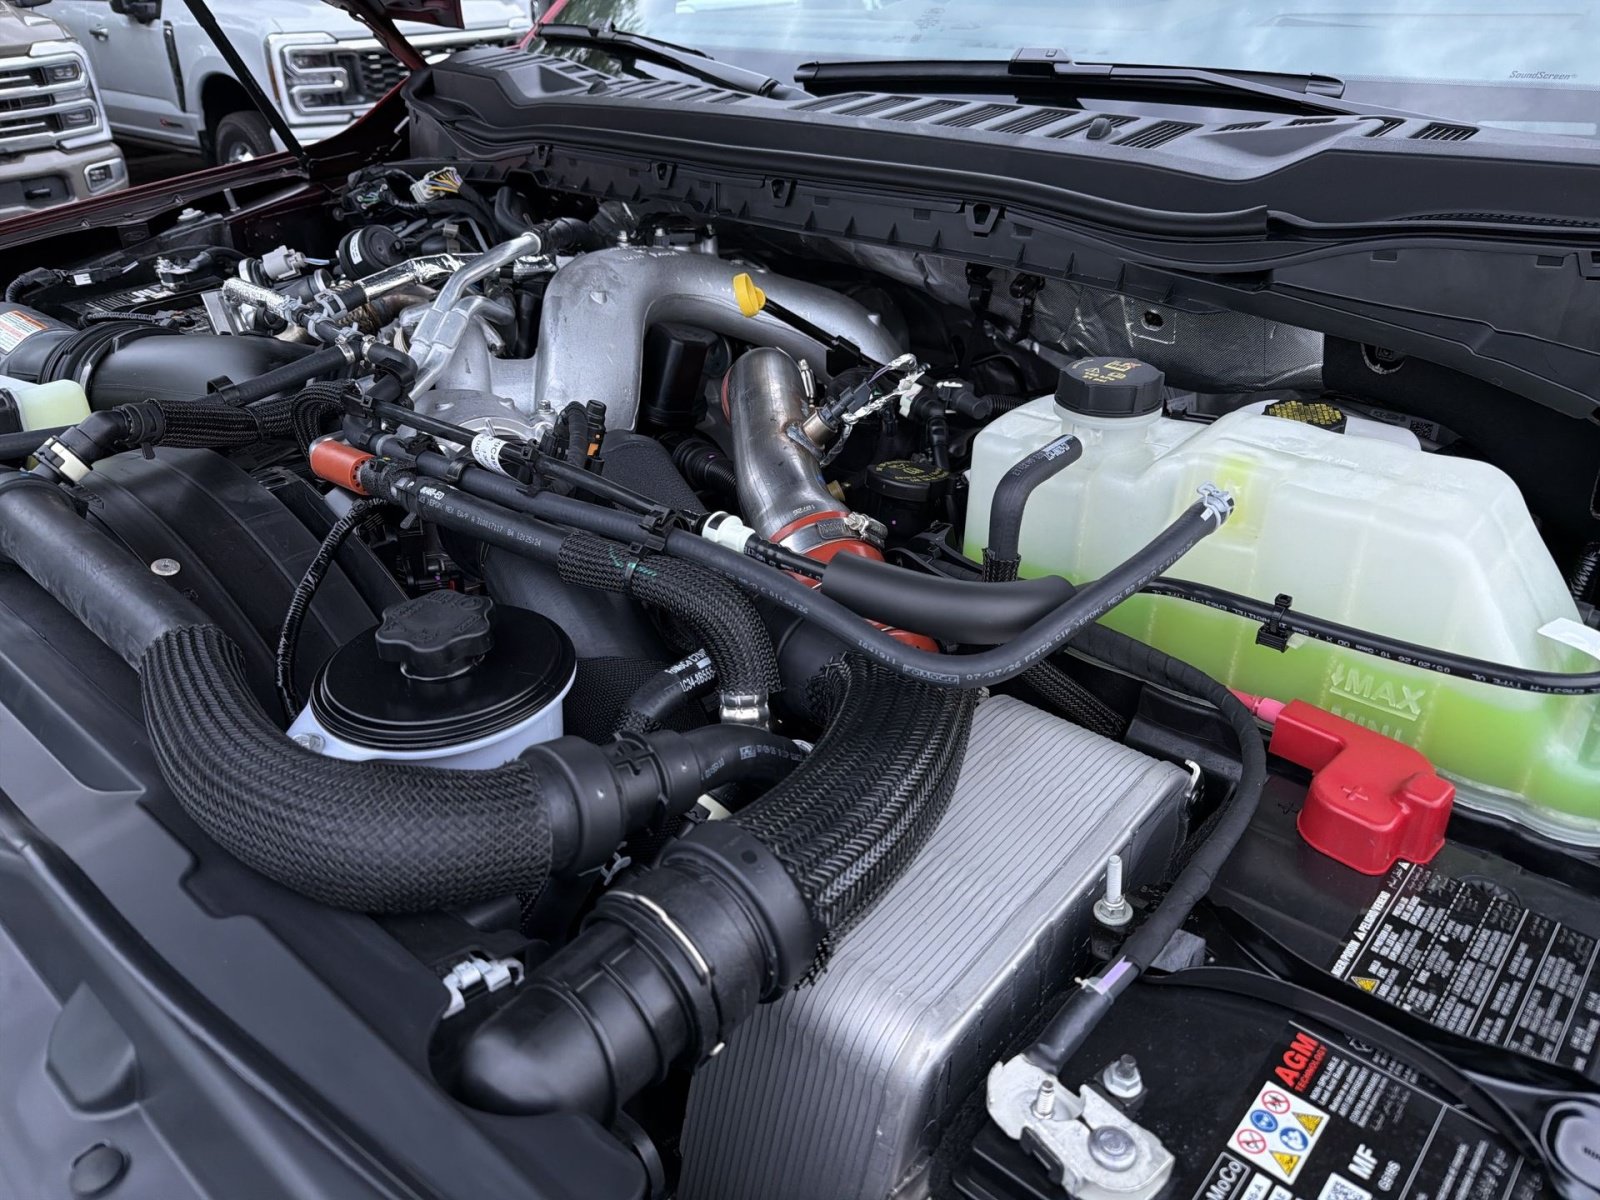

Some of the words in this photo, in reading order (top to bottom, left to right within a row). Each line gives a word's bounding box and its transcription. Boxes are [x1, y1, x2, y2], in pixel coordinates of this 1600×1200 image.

[1509, 70, 1571, 80] SoundScreen
[1343, 667, 1425, 715] MAX
[1274, 1032, 1318, 1086] AGM
[1294, 1044, 1329, 1093] TECHNOLOGY
[1201, 1157, 1246, 1200] MoCo
[1347, 1143, 1379, 1180] MF
